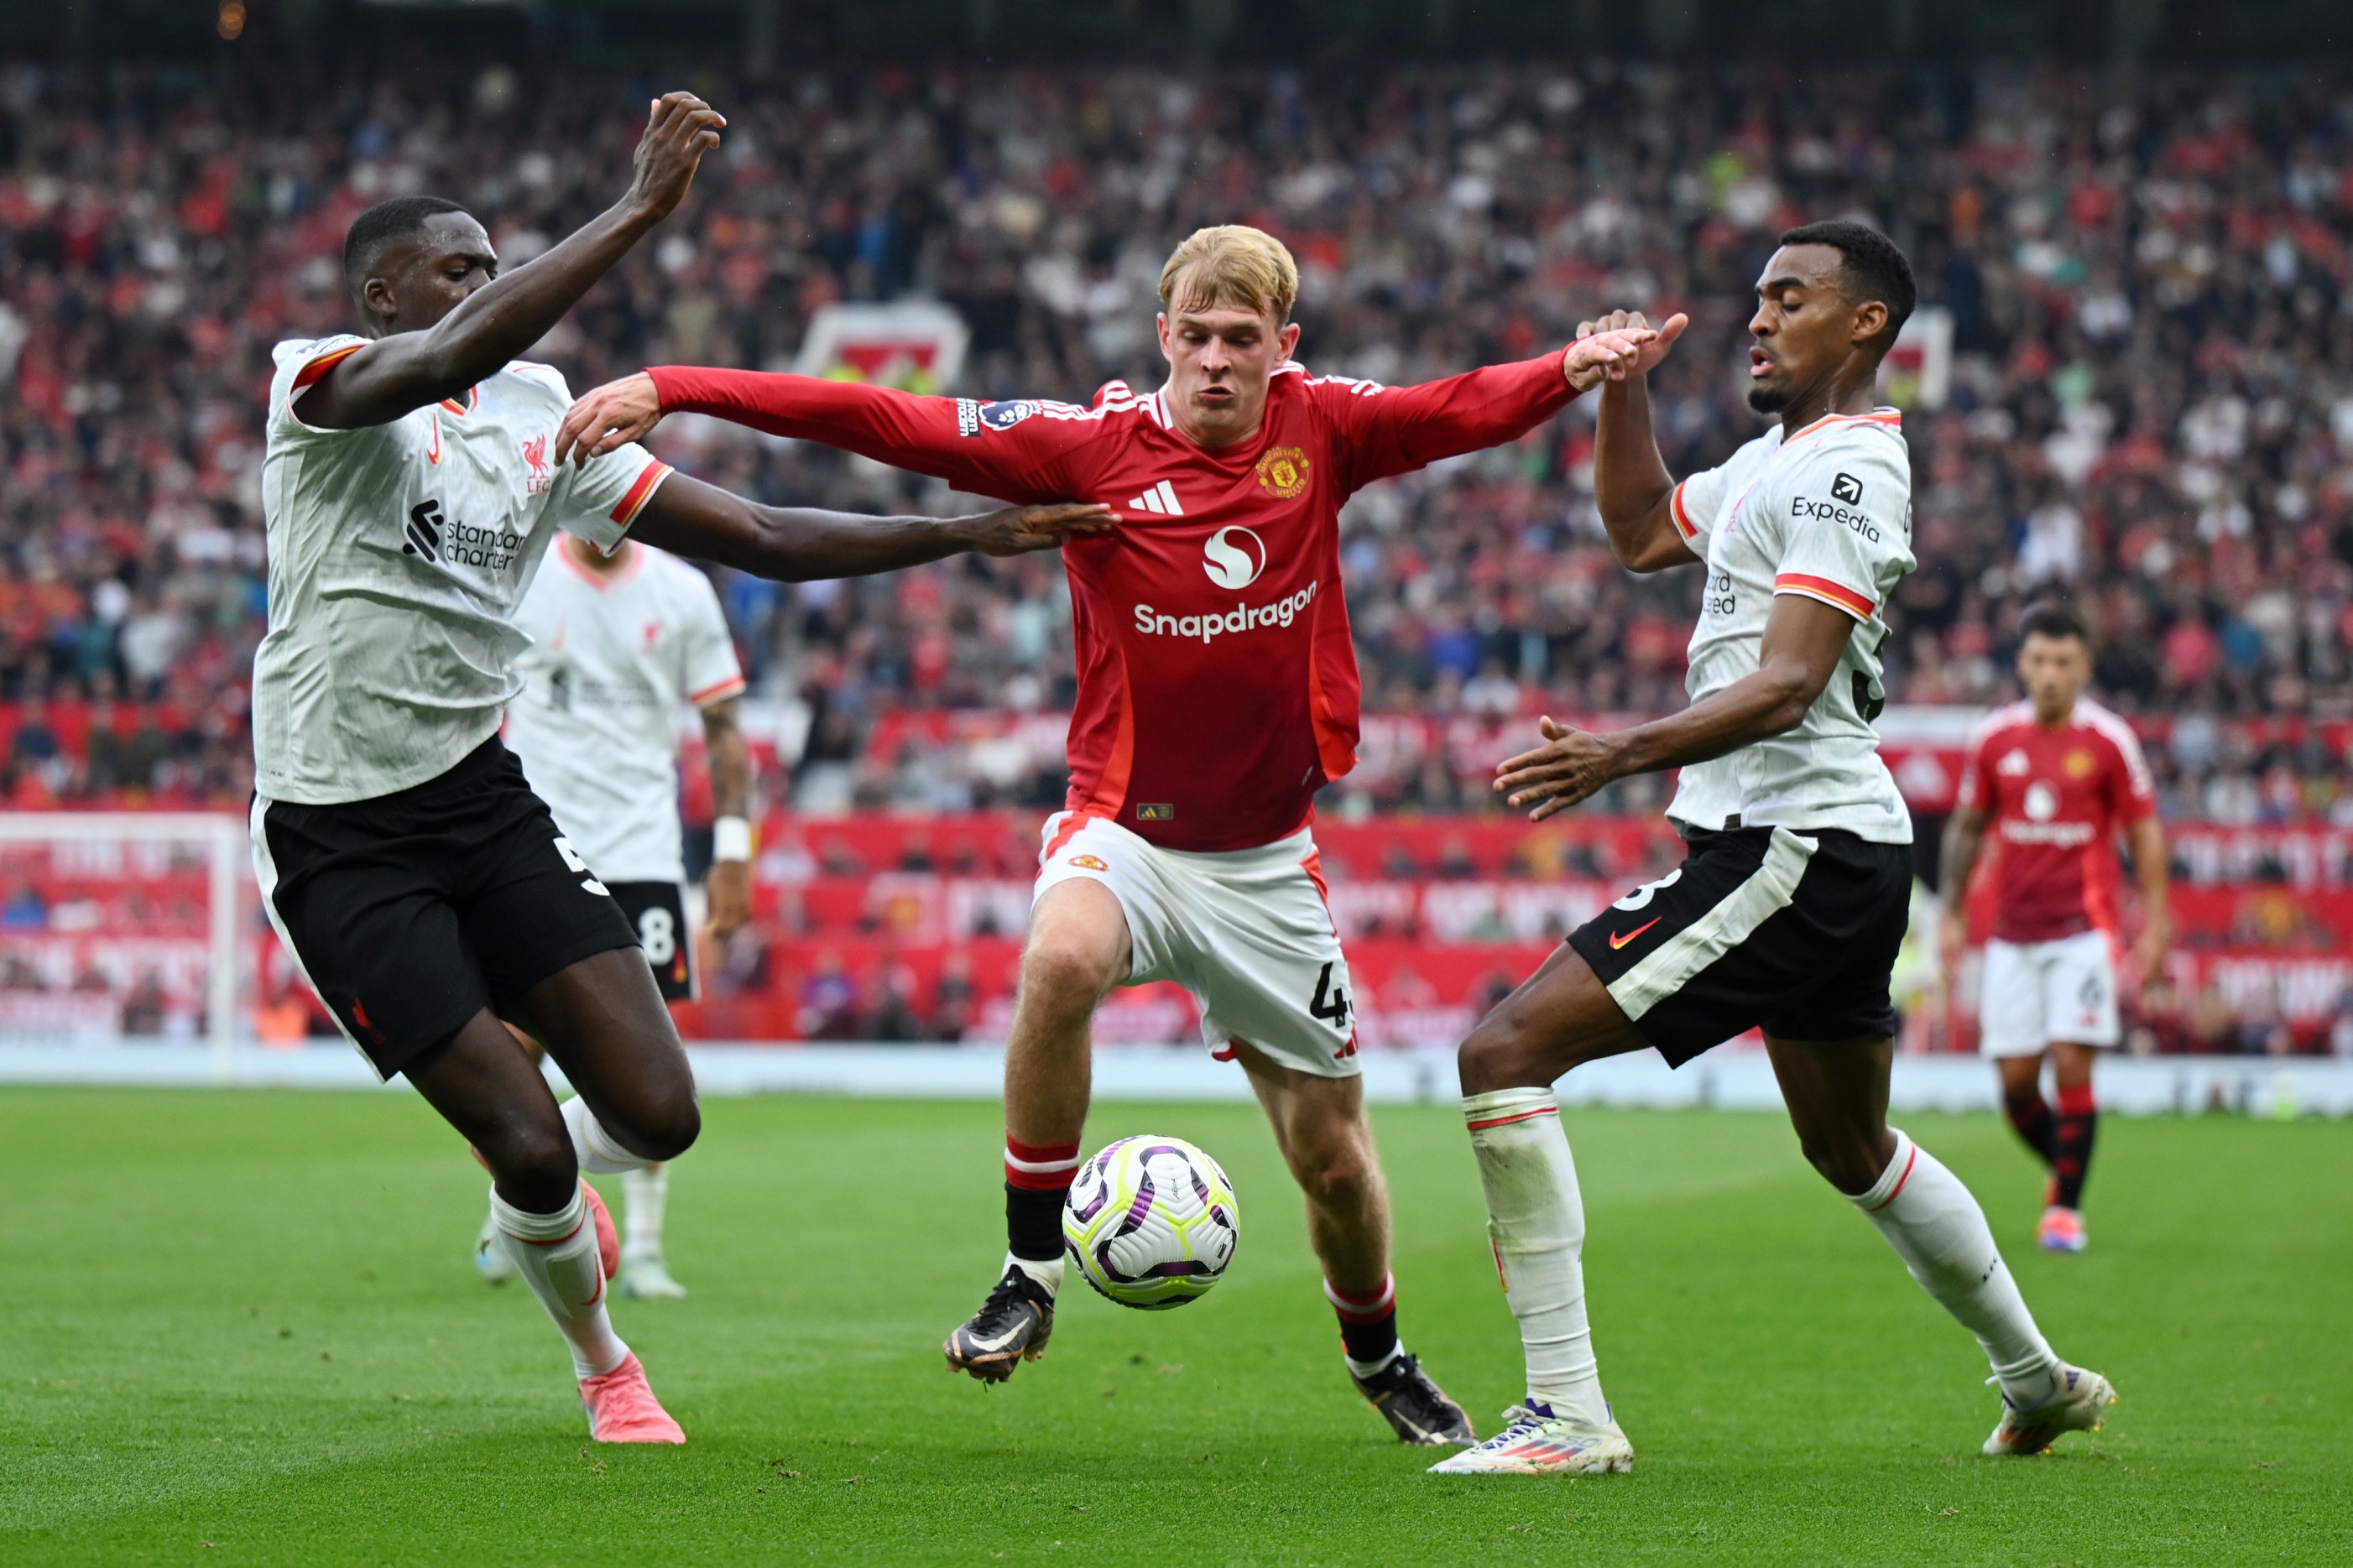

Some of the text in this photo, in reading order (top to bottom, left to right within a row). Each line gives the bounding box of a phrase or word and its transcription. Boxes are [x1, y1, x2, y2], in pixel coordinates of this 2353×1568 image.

[446, 520, 525, 550] standar
[1792, 497, 1880, 544] Expedia
[446, 543, 514, 570] charter
[1134, 580, 1317, 644] Snapdragon
[638, 906, 676, 966] 8
[1309, 961, 1354, 1028] 4
